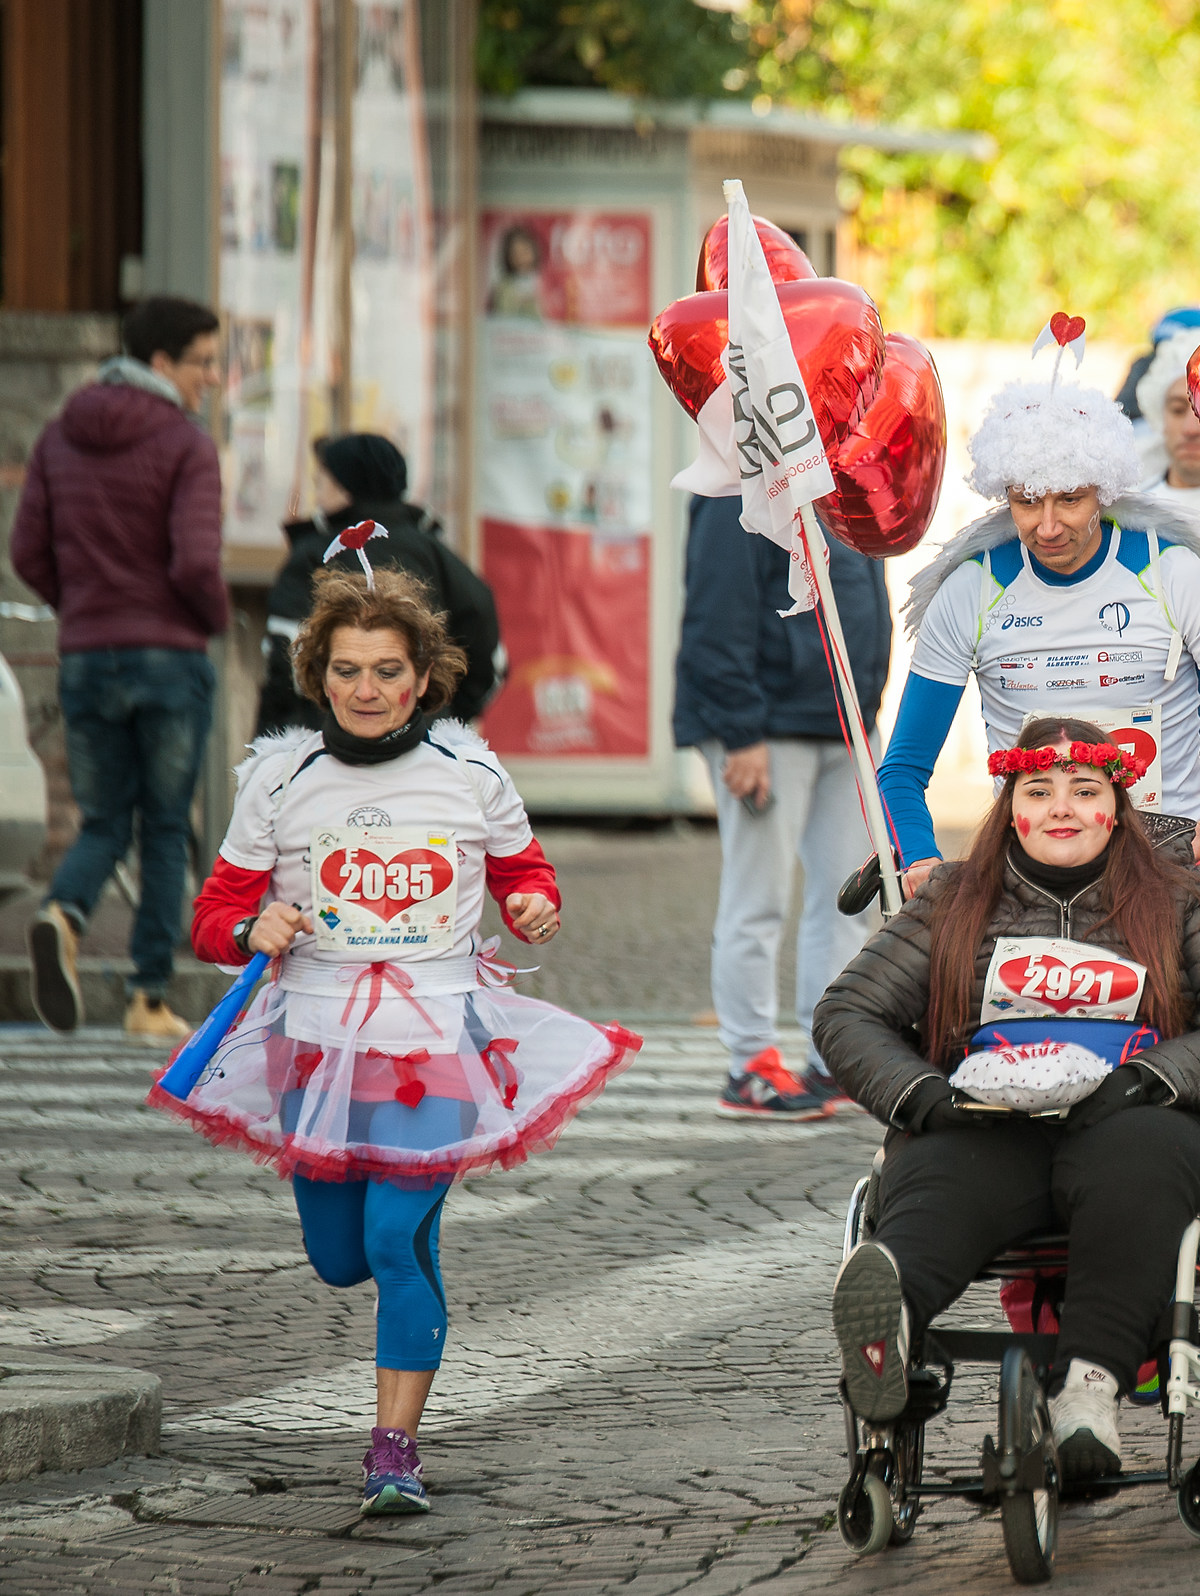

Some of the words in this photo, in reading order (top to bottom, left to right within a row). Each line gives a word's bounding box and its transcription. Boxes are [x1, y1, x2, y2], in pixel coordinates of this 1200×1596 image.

[1014, 615, 1043, 628] asics
[345, 848, 360, 865] F
[339, 863, 433, 901] 2035
[346, 936, 377, 945] TACCHI
[378, 935, 401, 944] ANNA
[402, 934, 429, 944] MARIA
[1028, 954, 1043, 968] F
[1020, 965, 1115, 1004] 2921
